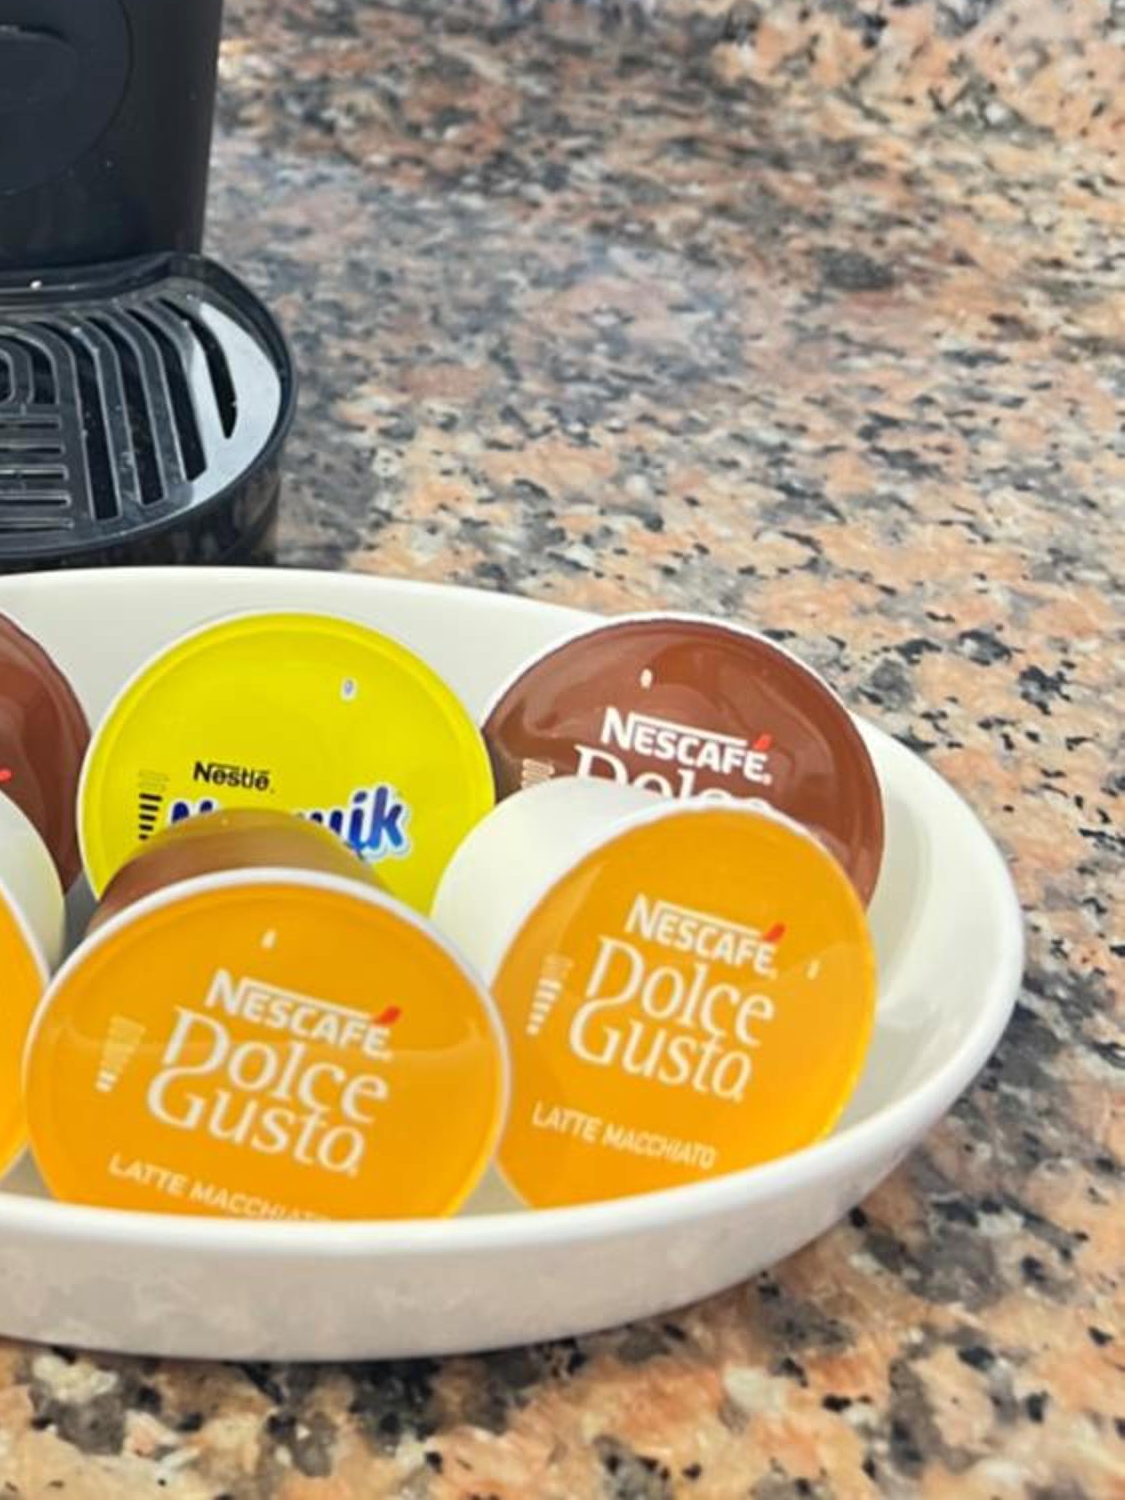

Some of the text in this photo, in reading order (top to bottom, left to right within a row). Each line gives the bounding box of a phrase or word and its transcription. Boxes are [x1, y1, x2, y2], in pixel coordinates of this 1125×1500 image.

[586, 934, 774, 1046] Dolce
[163, 1005, 390, 1123] Dolce
[569, 998, 752, 1103] Gusto
[108, 1152, 188, 1197] LATTE
[147, 1065, 364, 1178] Gusto
[532, 1101, 718, 1170] LATTE MACCHIATO
